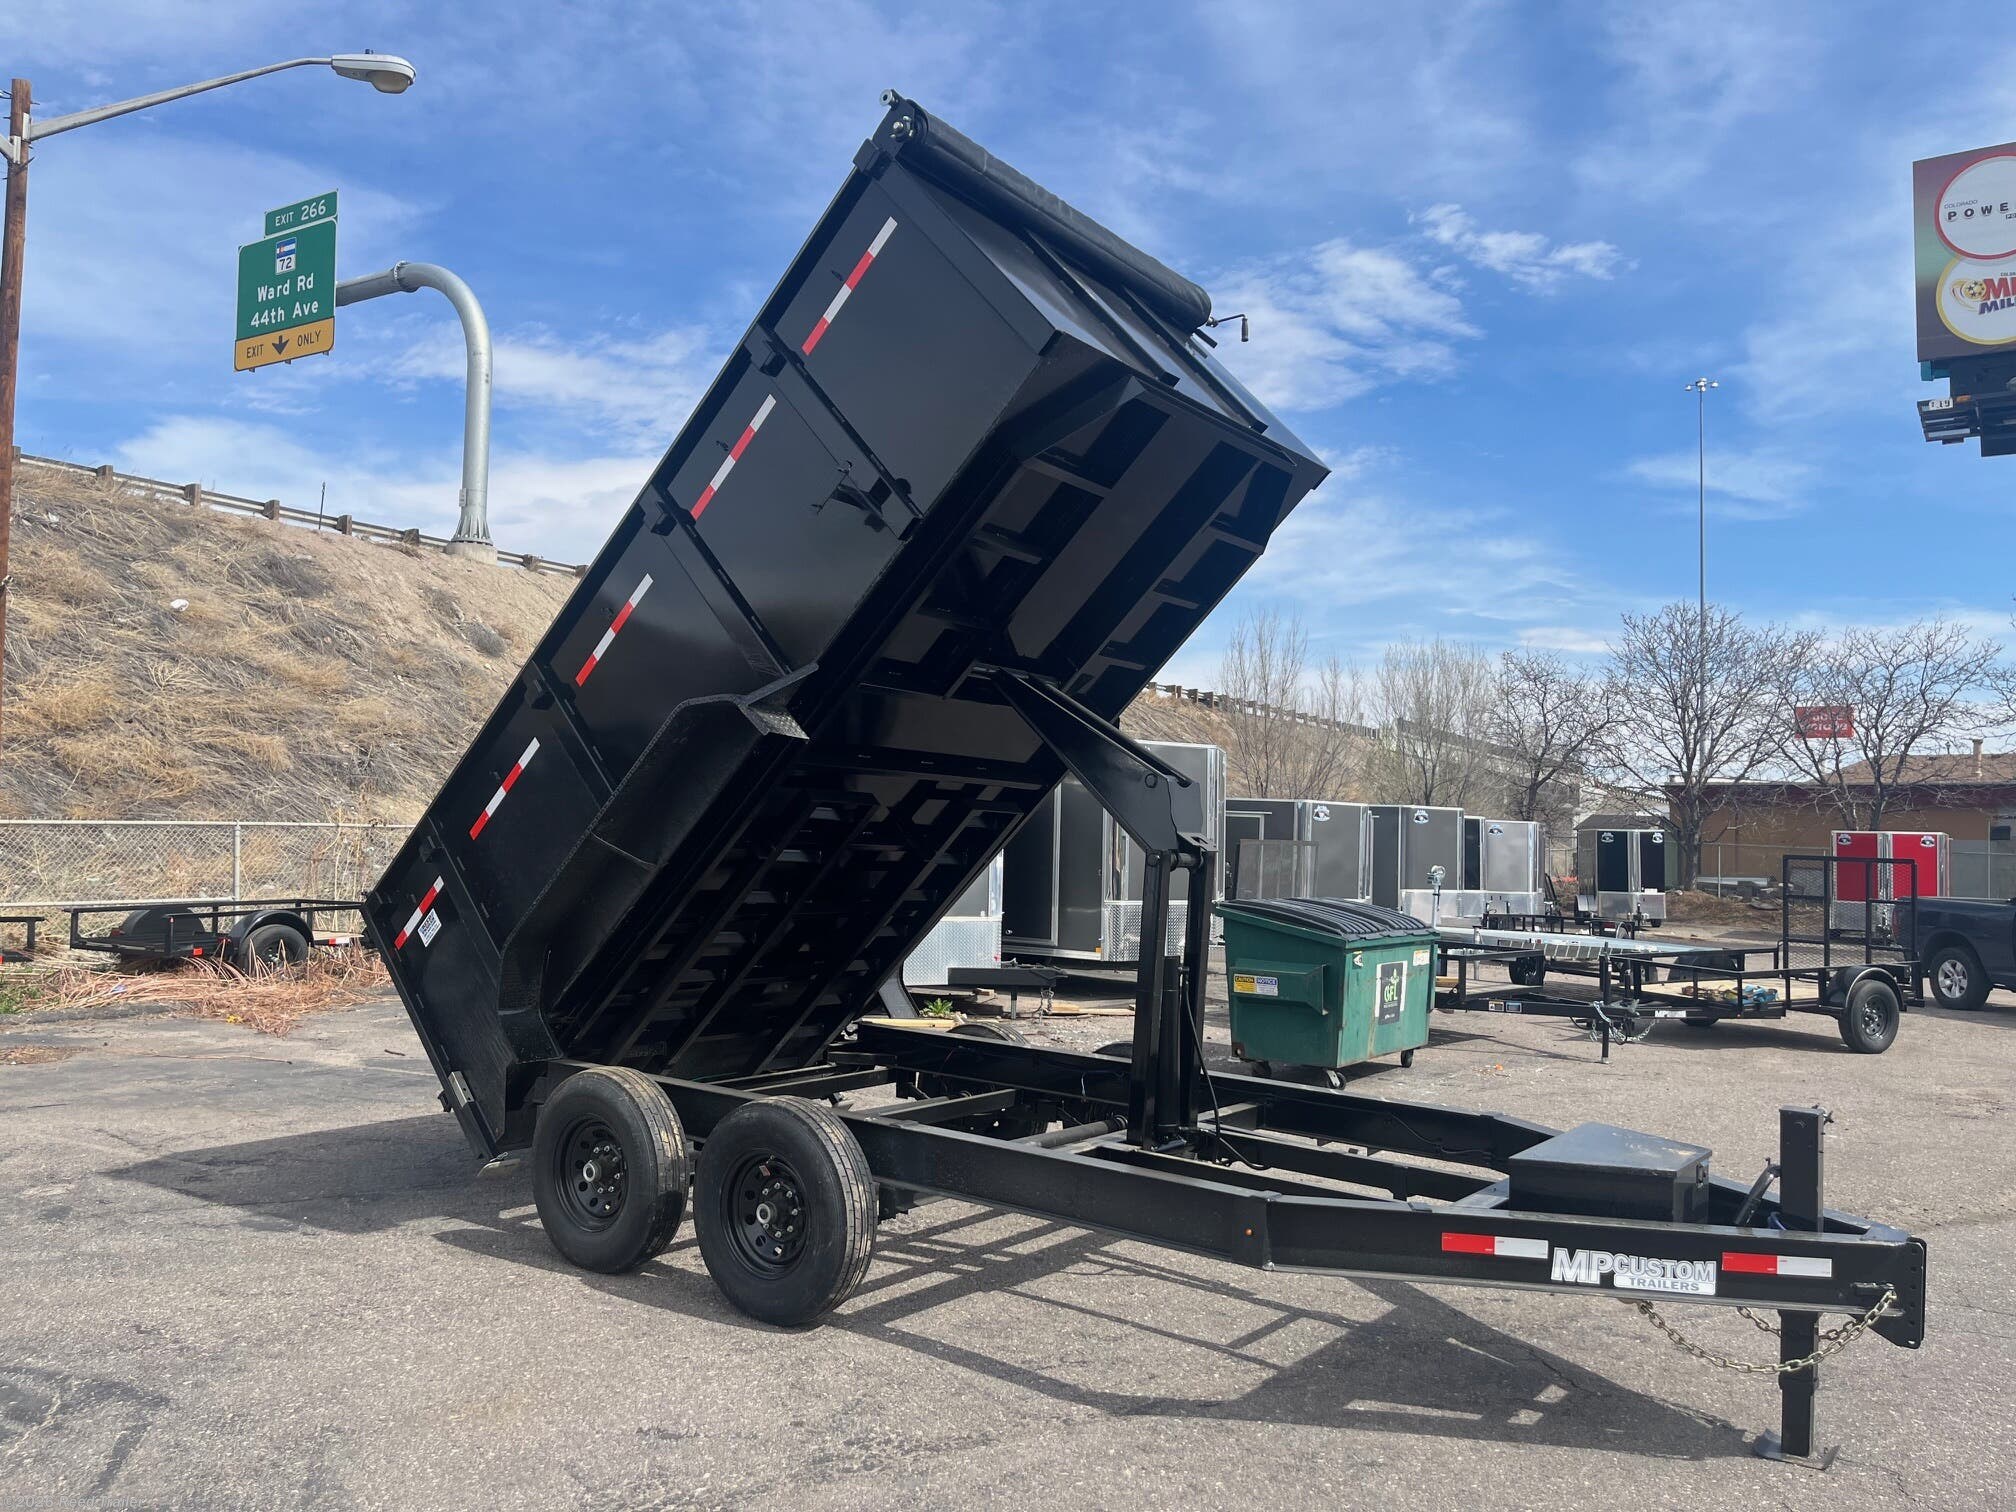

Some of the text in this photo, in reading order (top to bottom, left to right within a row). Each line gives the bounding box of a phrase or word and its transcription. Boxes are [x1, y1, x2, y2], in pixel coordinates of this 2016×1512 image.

[275, 200, 326, 227] EXIT 266
[279, 257, 292, 270] 72
[257, 272, 314, 302] Ward Rd
[250, 301, 319, 328] 44th Ave
[1979, 297, 2016, 315] MIL
[246, 330, 321, 358] EXIT ONLY
[1629, 1277, 1700, 1292] TRAILERS
